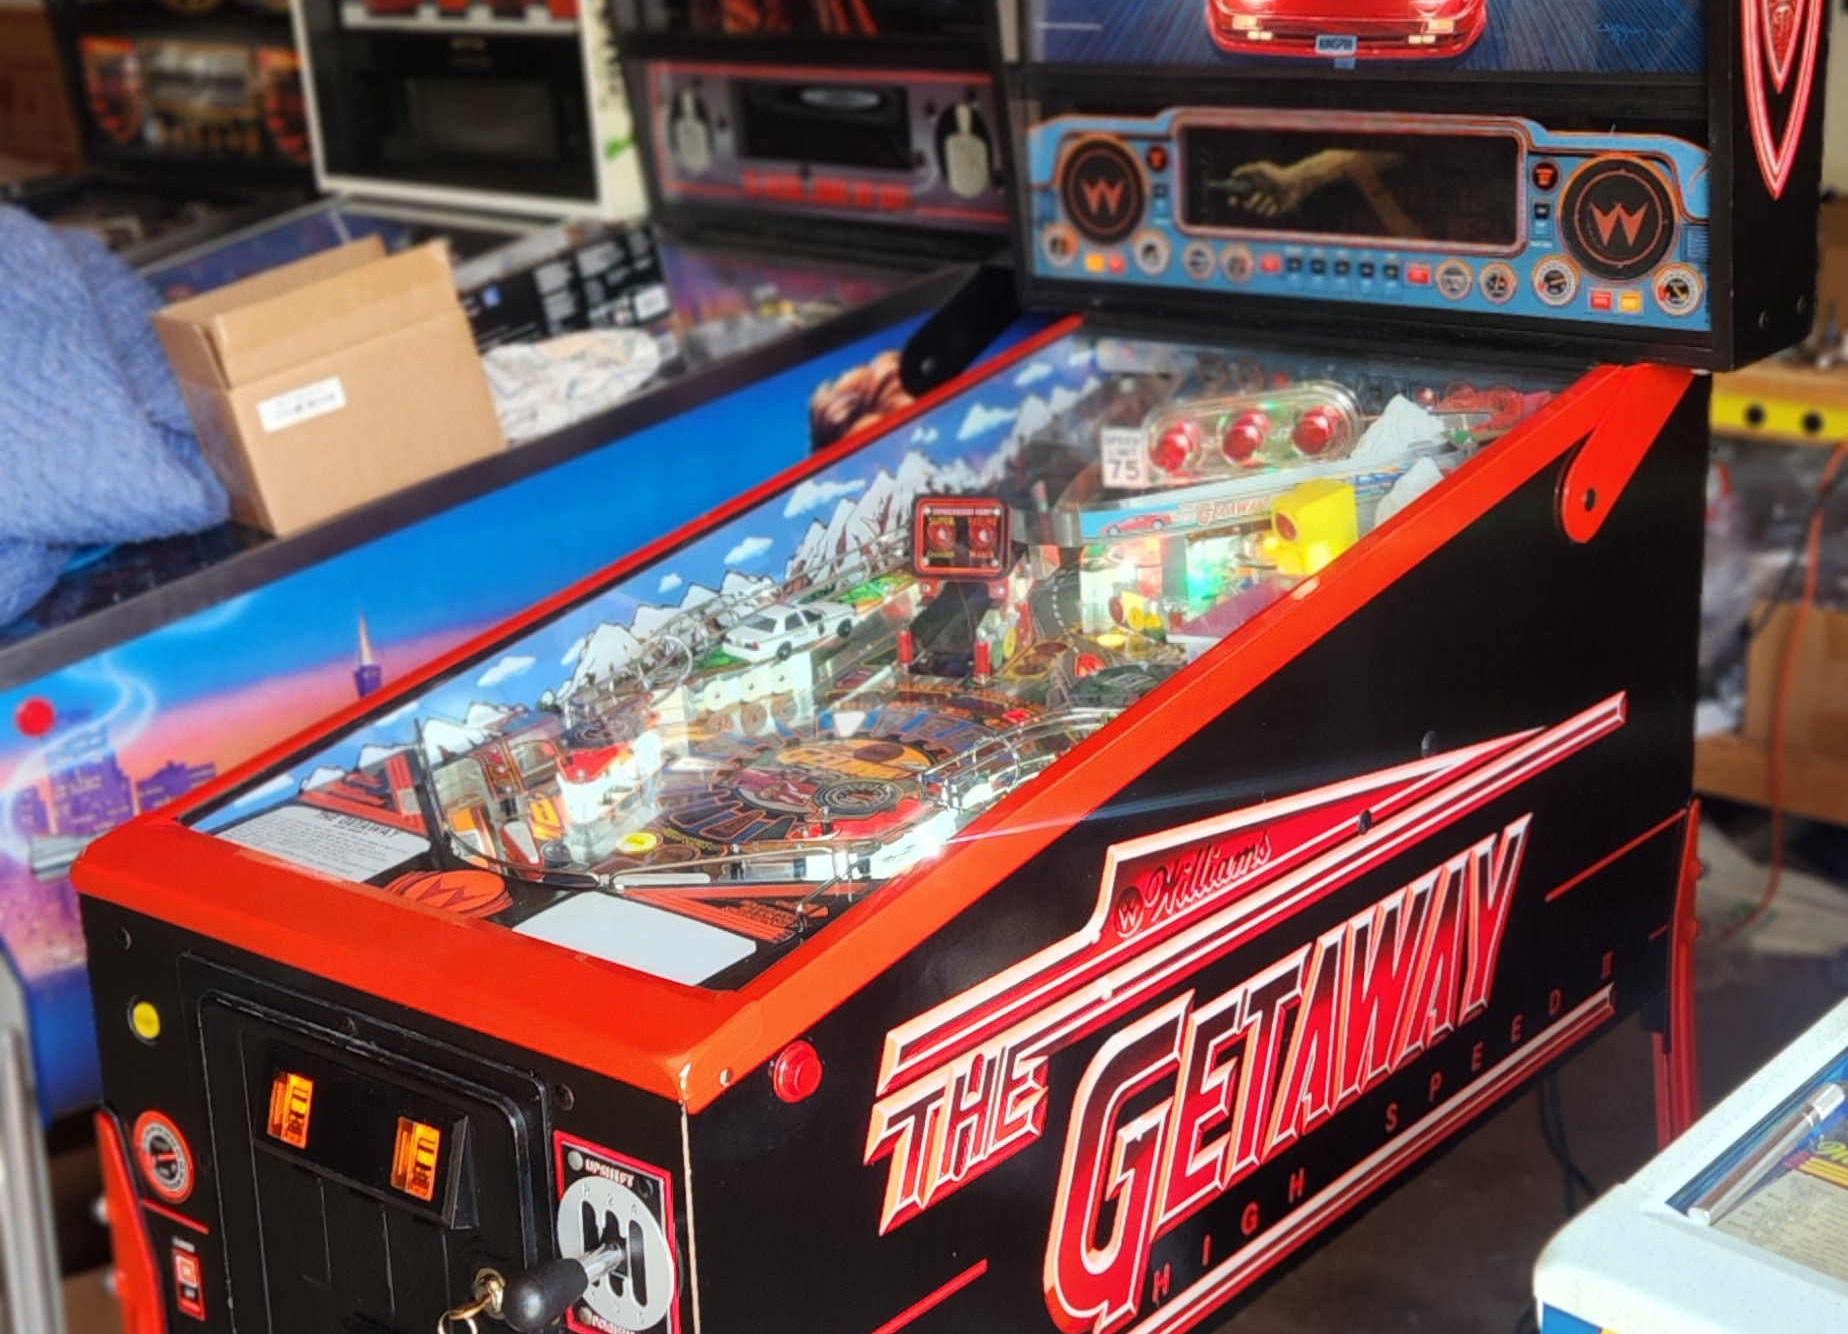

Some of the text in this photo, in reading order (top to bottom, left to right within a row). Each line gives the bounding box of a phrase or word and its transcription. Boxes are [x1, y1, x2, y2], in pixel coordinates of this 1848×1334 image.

[1106, 458, 1141, 482] 75
[338, 815, 400, 839] GETAWAY
[1143, 829, 1272, 923] Williams
[864, 1037, 1049, 1237] THE
[1151, 1167, 1305, 1304] HIGH
[1385, 987, 1562, 1133] SPEED
[584, 1157, 636, 1189] UPSHIFT
